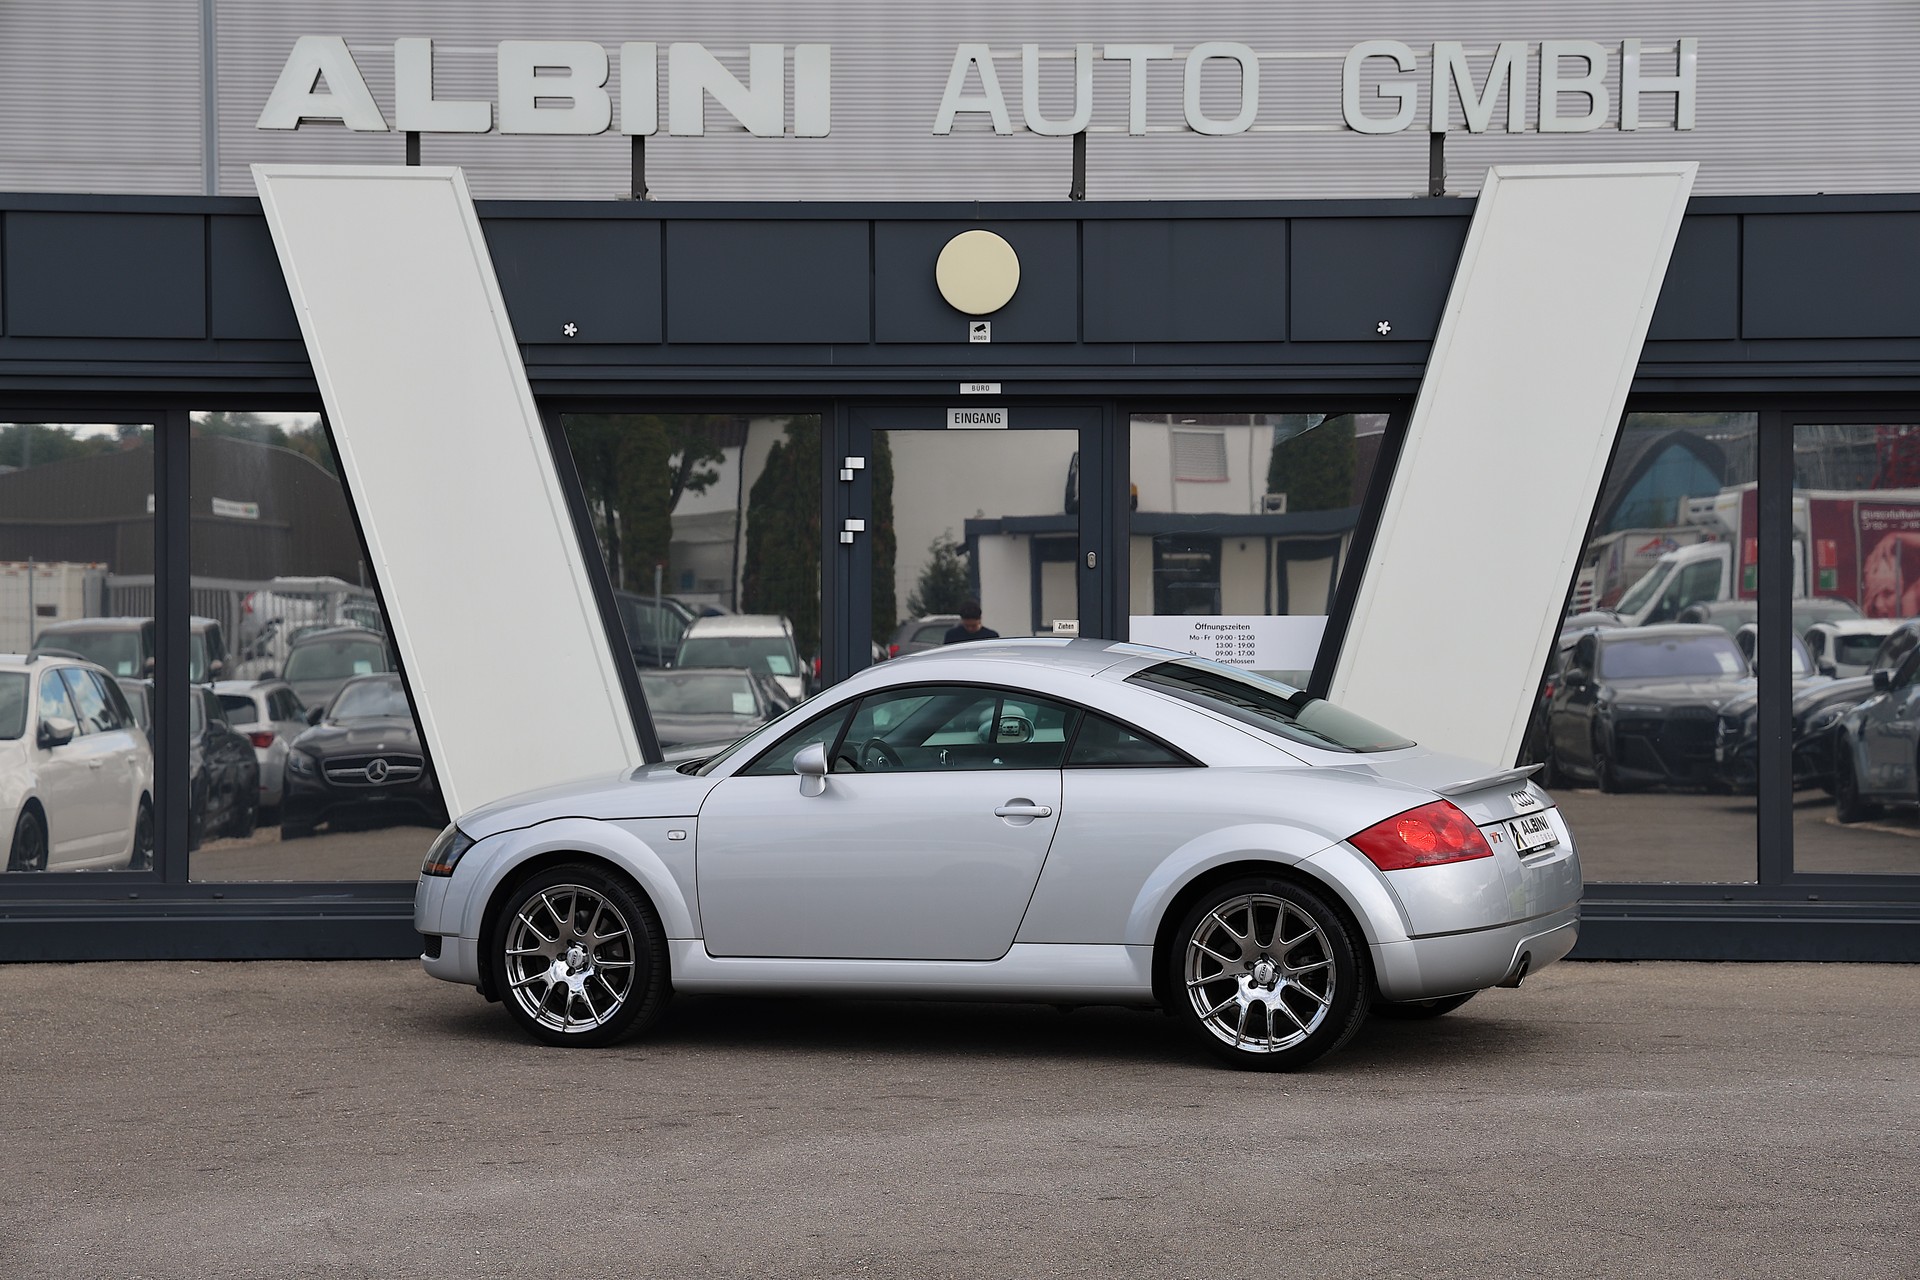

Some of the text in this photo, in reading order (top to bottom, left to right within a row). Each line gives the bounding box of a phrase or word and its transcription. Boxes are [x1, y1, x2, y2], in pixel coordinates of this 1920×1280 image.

[256, 36, 1699, 138] ALBINI AUTO GMBH
[971, 383, 990, 392] BÜRO
[954, 412, 1001, 424] EINGANG
[1057, 622, 1075, 630] Ziehen
[1195, 622, 1250, 631] Öffnungszeiten
[1521, 815, 1549, 835] ALBINI
[1489, 831, 1504, 844] TT
